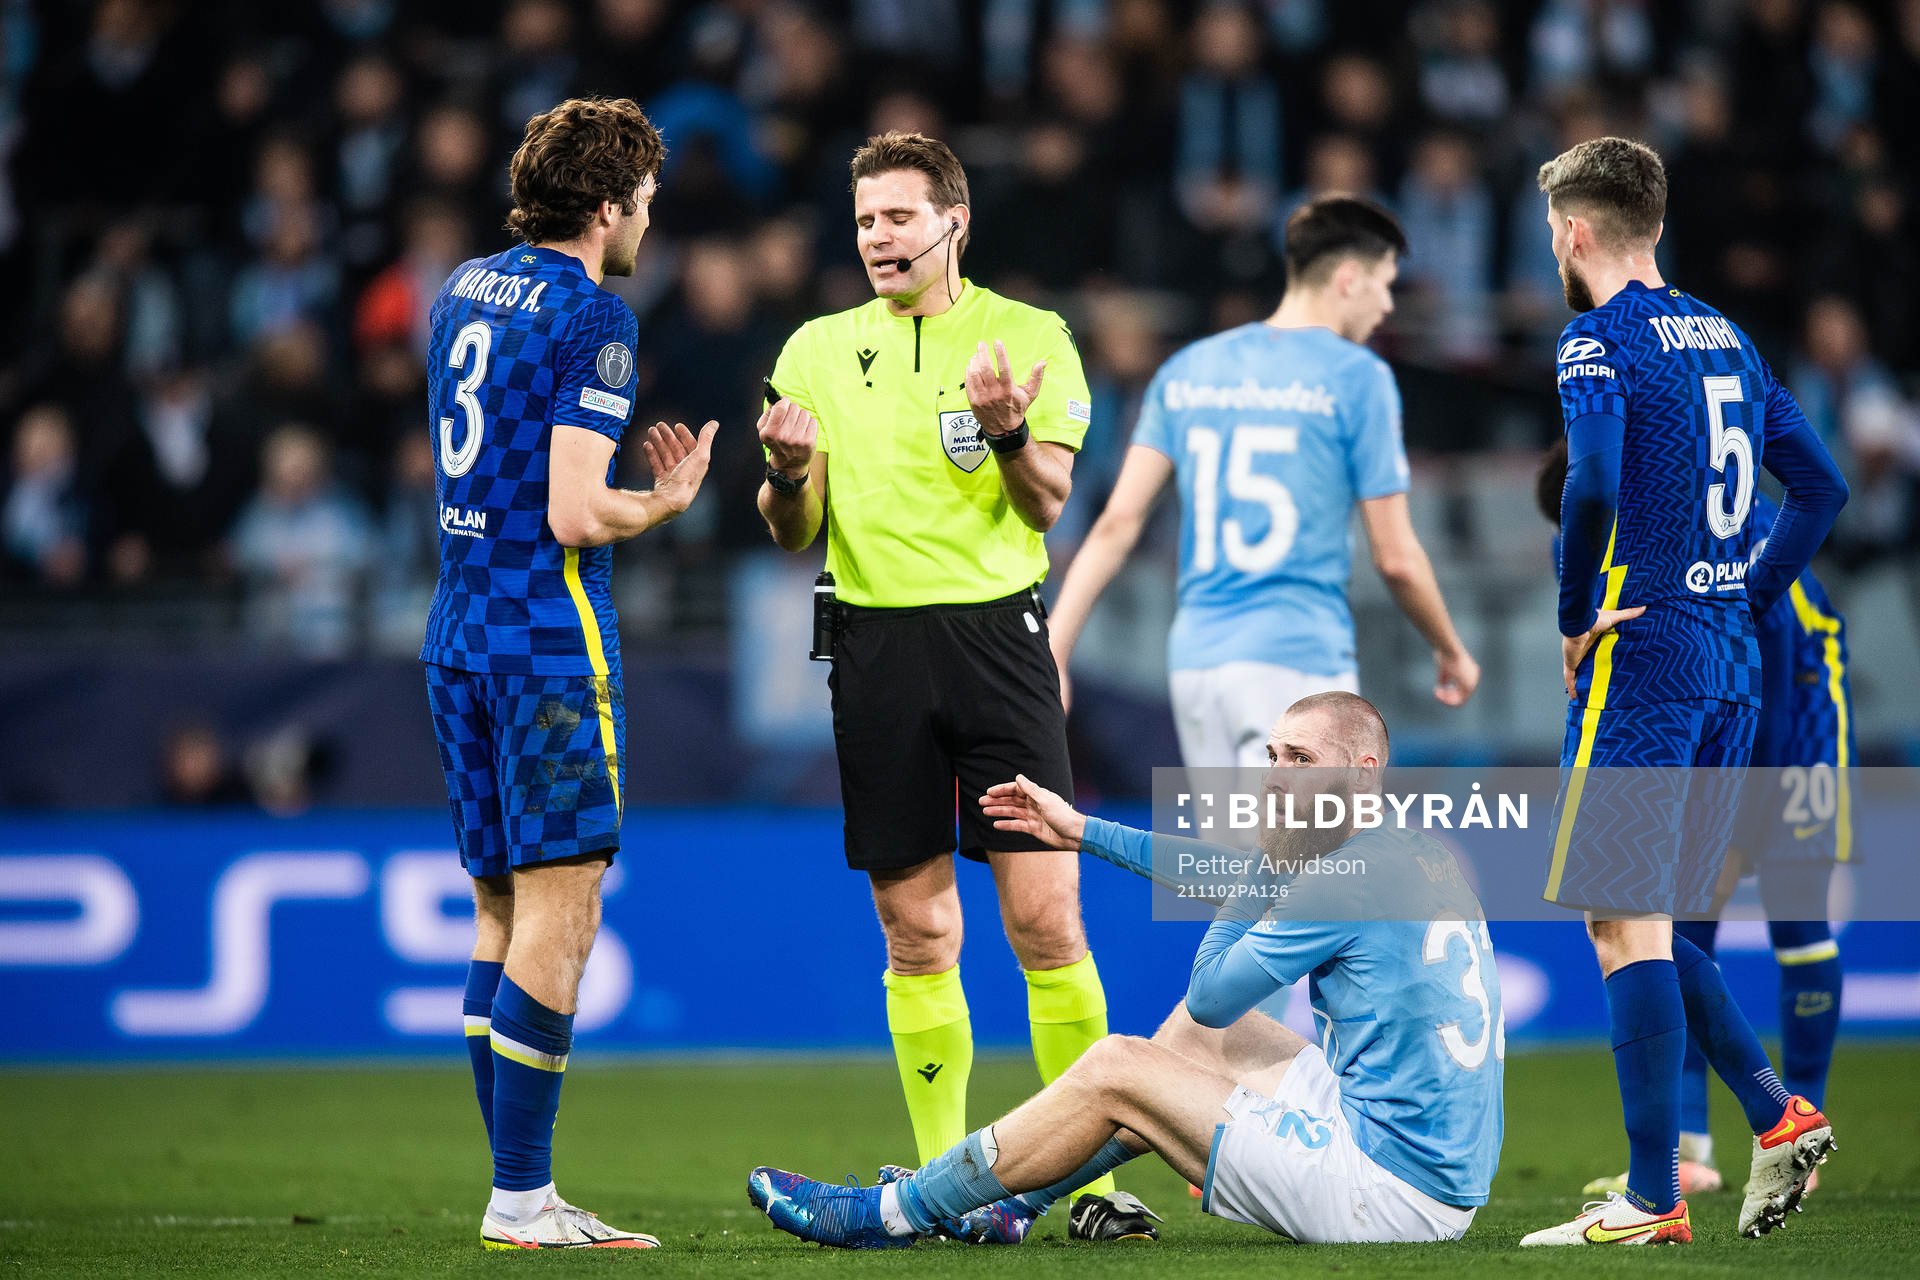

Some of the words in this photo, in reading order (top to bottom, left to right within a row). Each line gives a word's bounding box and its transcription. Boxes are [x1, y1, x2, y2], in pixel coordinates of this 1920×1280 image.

[520, 254, 537, 264] CFC
[451, 267, 530, 308] MARCOS
[520, 281, 548, 313] A.
[440, 321, 492, 478] 3
[1557, 364, 1616, 389] YUNDAI
[950, 445, 985, 454] OFFICIAL
[1703, 376, 1754, 540] 5
[445, 507, 487, 530] PLAN
[1186, 426, 1298, 573] 15
[1779, 761, 1837, 824] 20
